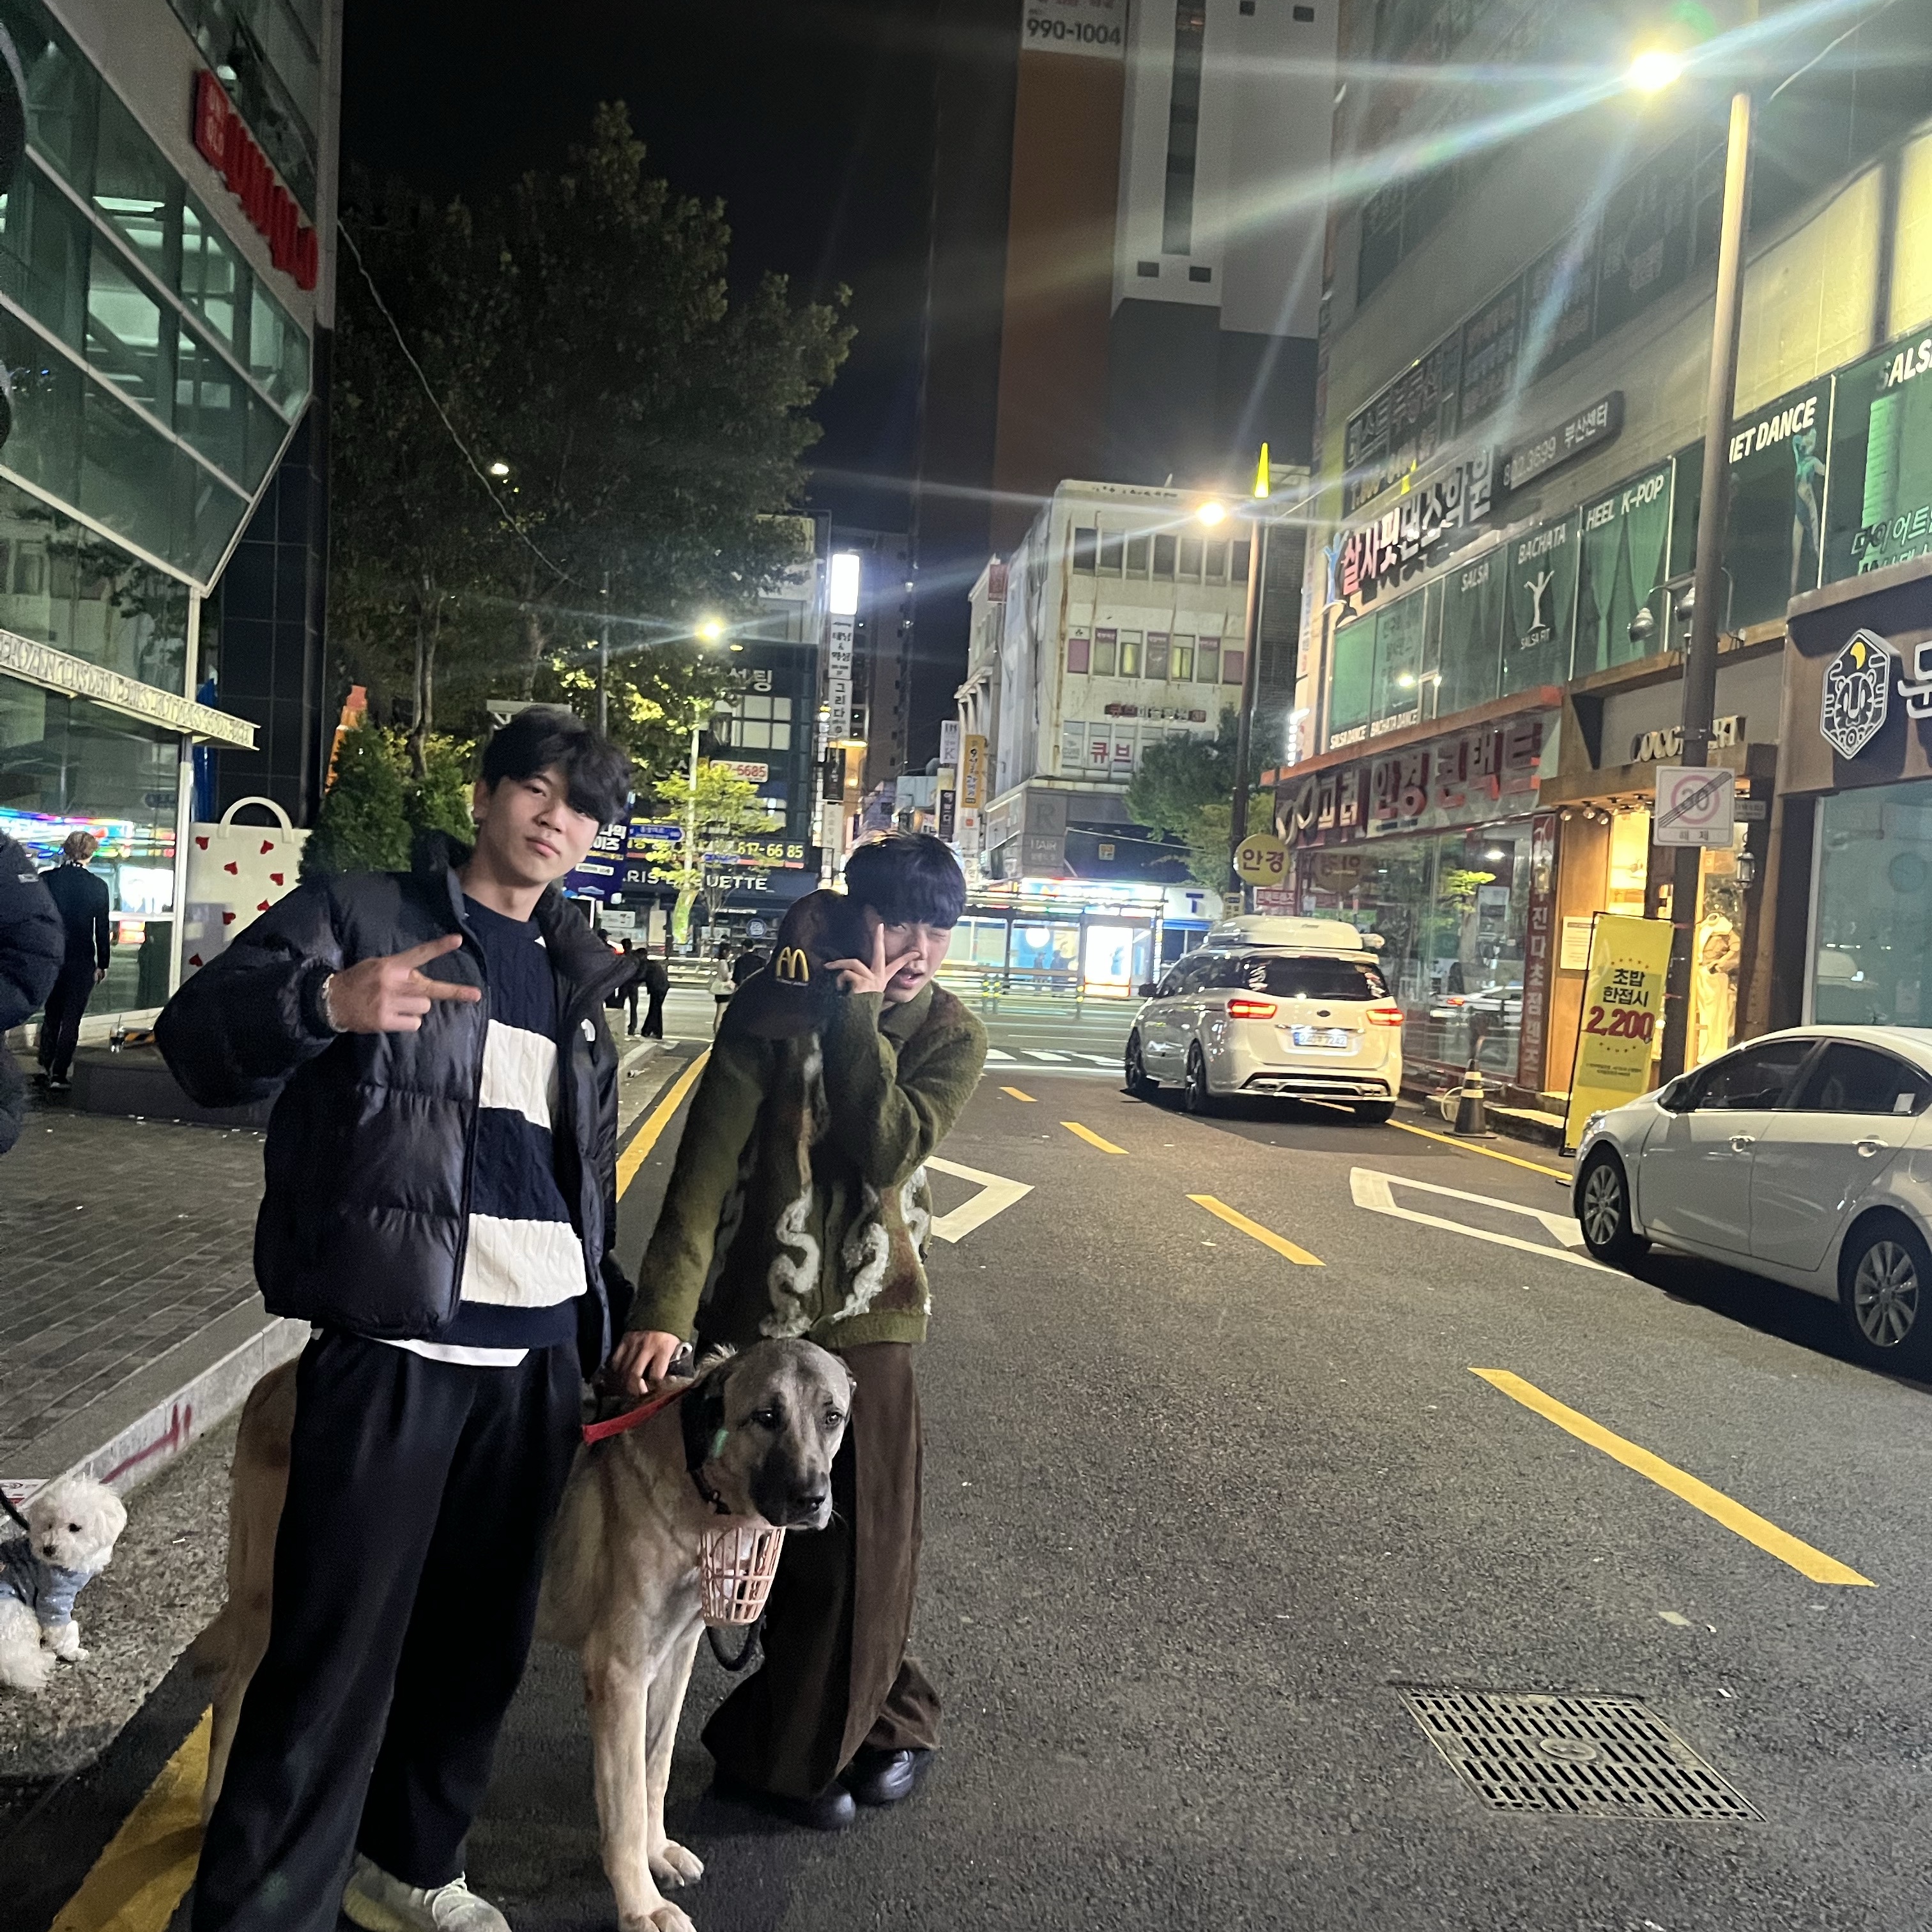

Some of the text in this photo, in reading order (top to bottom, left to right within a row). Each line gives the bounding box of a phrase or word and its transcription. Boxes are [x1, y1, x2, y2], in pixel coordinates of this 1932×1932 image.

[1027, 17, 1121, 46] 990-1004
[1875, 339, 1932, 392] SALS
[1565, 401, 1608, 448] 부산센터
[1729, 396, 1817, 464] IET DANCE
[1586, 475, 1664, 531] HEEL K-POP
[1518, 523, 1566, 565] BACHATA
[1461, 562, 1489, 592] SALSA
[1242, 848, 1284, 873] 안경
[1613, 968, 1645, 988] 초밥
[1602, 986, 1649, 1008] 한접시
